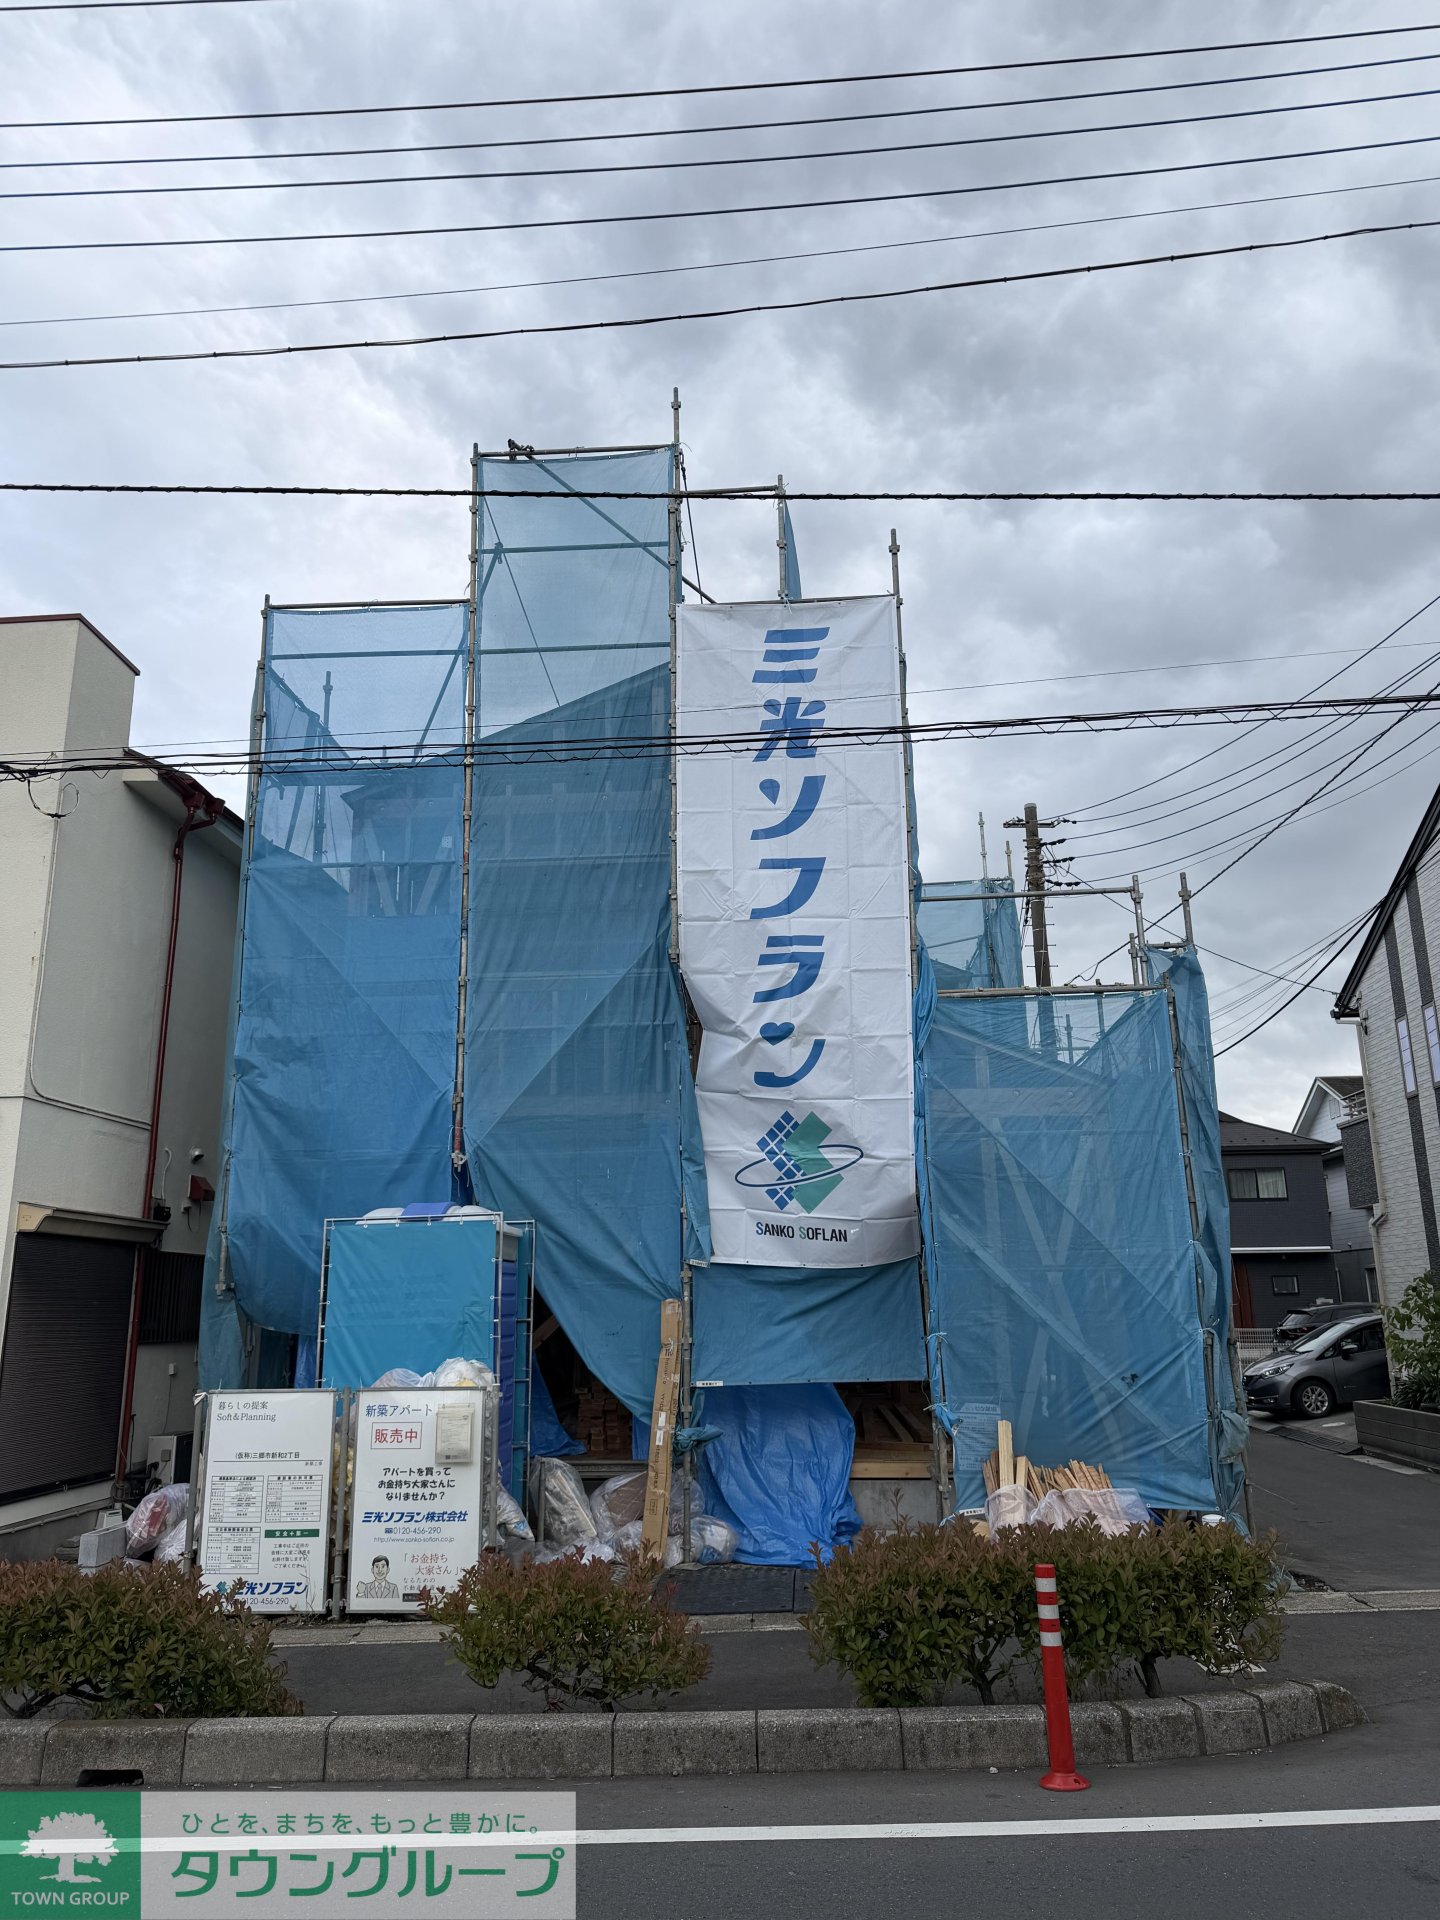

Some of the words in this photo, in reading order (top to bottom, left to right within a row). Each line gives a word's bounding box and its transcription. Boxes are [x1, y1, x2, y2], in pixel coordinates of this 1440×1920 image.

[751, 626, 830, 1088] 三光ソフラン
[756, 1222, 794, 1239] SANKO
[798, 1226, 847, 1242] SOFLAN
[218, 1400, 269, 1411] 暮らしの提案
[365, 1403, 433, 1418] 新築アパート
[374, 1428, 418, 1444] 販売中
[382, 1467, 452, 1477] アパートを買って
[377, 1479, 456, 1489] お金持ち大家さんに
[361, 1510, 469, 1524] 三光ソフラン株式会社
[393, 1526, 442, 1535] 0120-456-290
